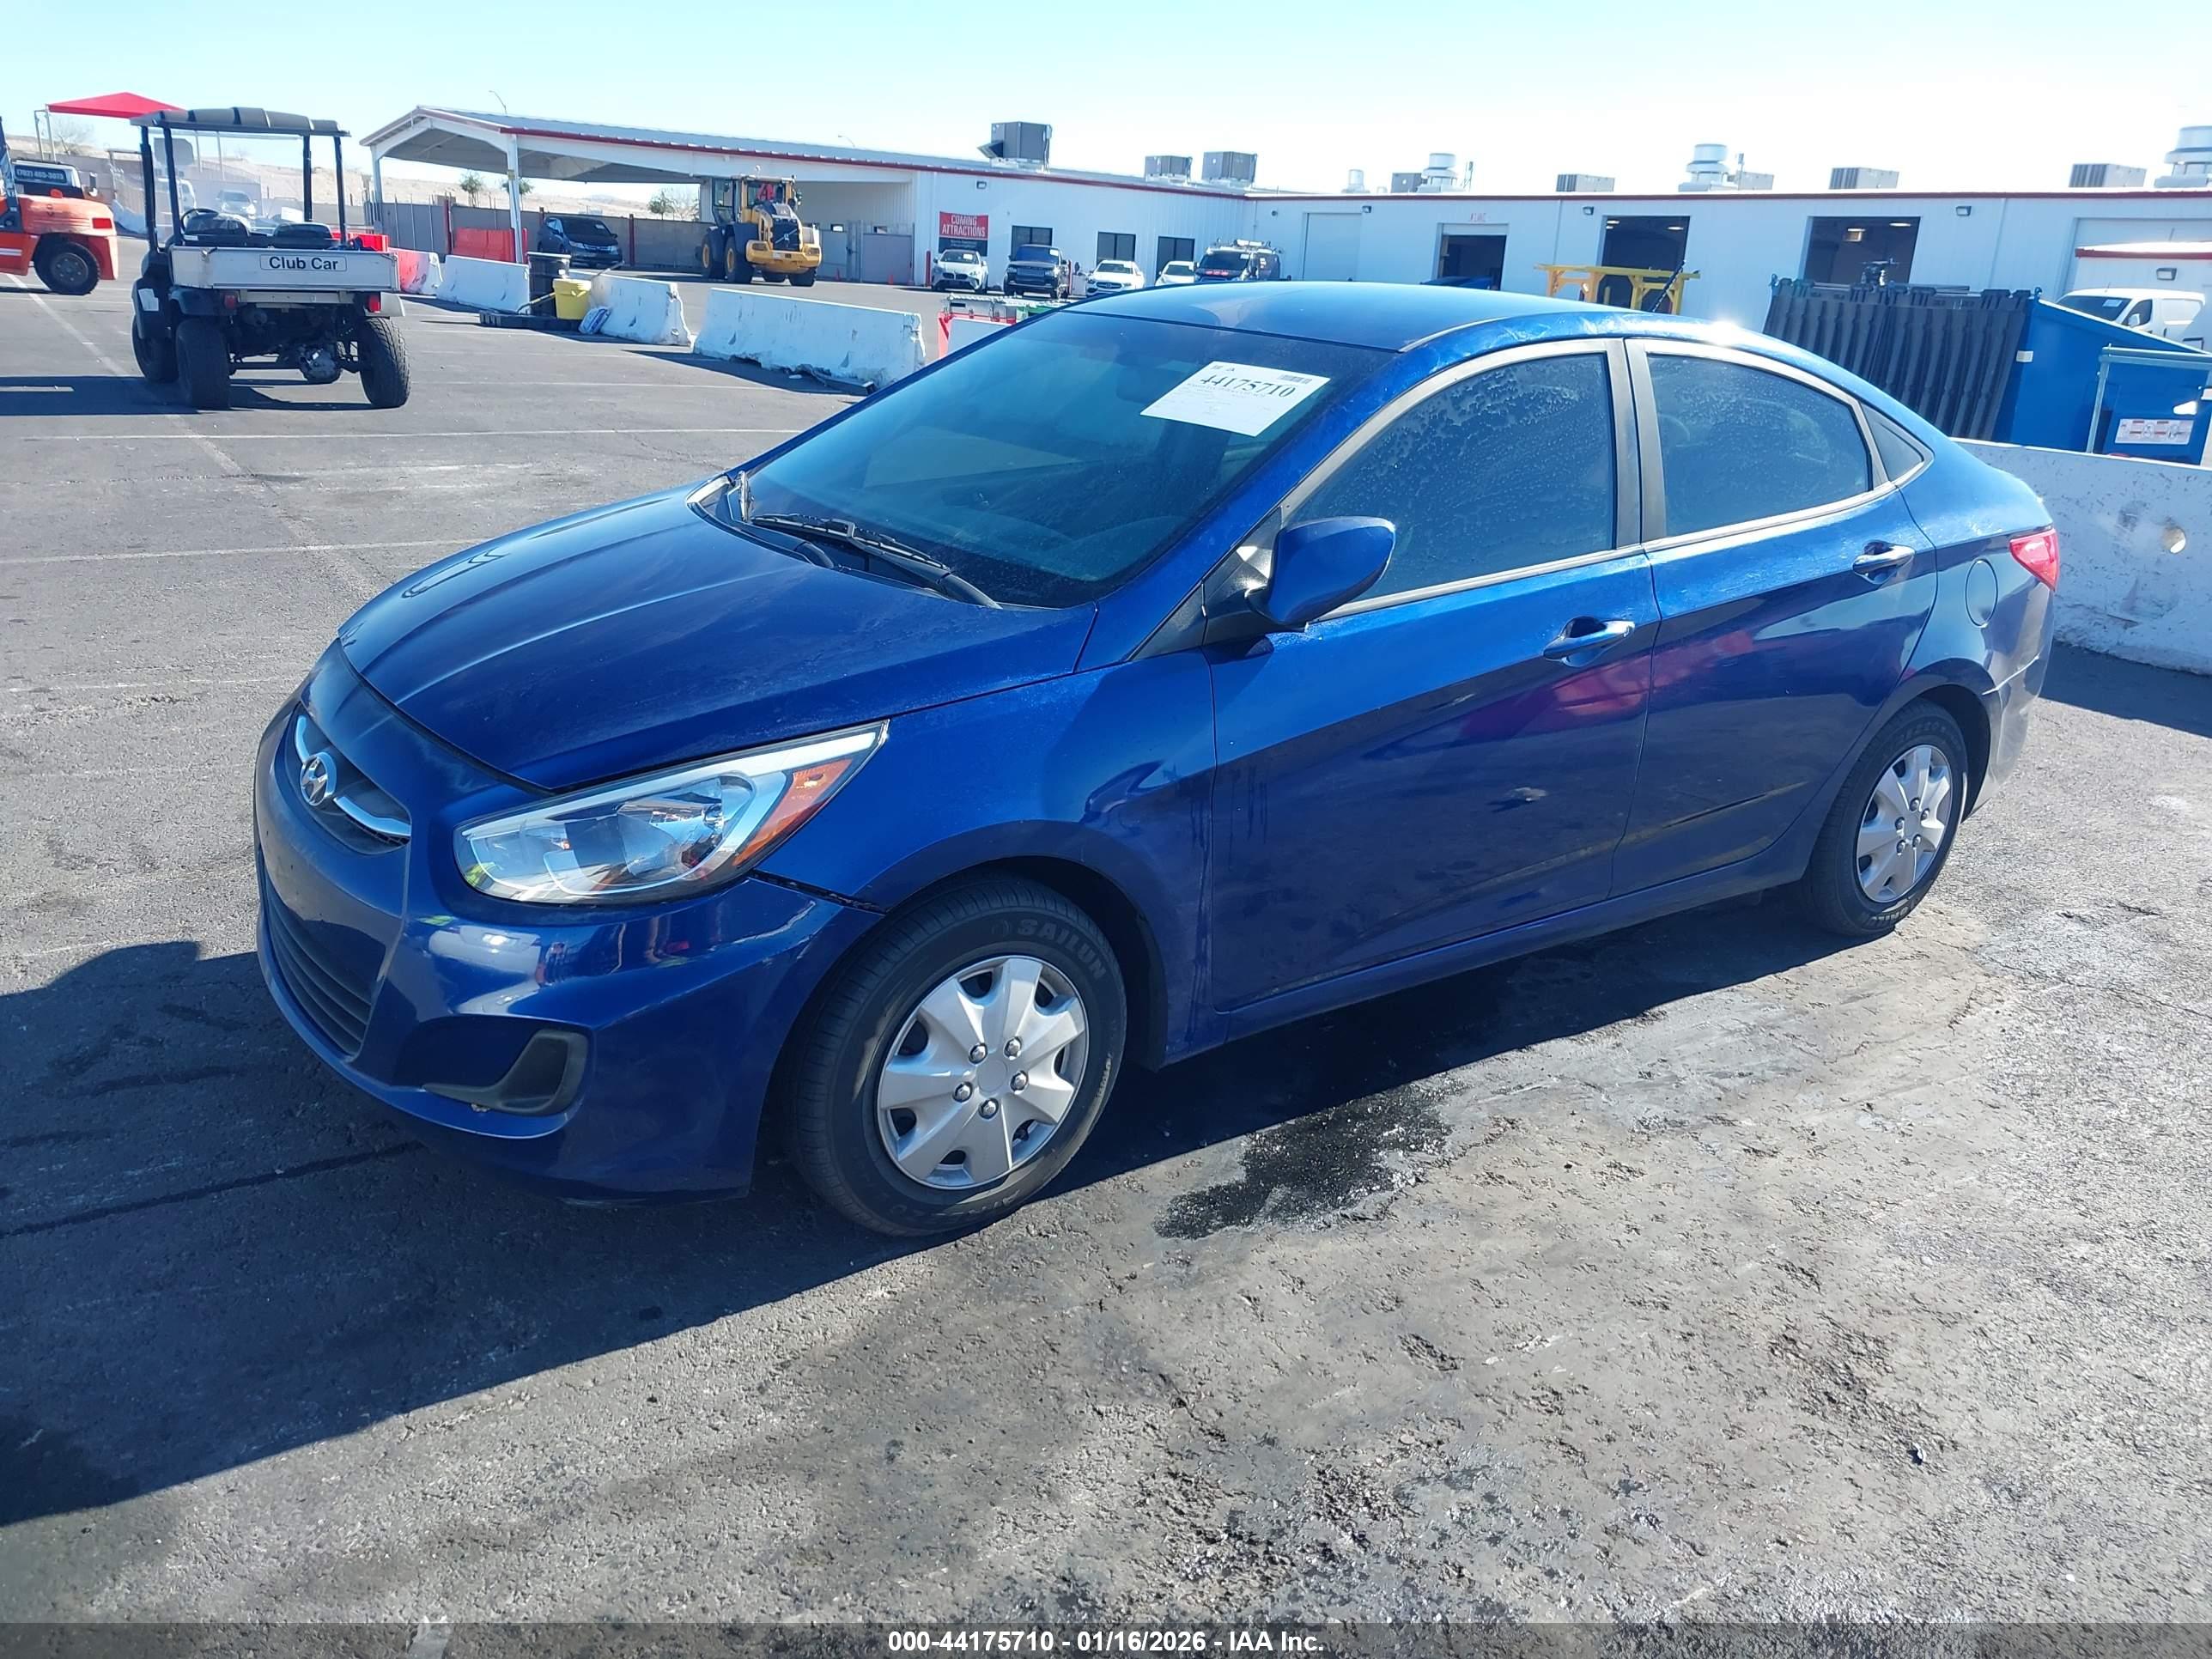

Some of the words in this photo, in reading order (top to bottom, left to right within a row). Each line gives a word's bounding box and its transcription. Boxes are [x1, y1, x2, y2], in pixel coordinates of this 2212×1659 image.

[951, 214, 977, 226] COMING
[941, 223, 986, 238] ATTRACTIONS
[269, 256, 307, 270] Club
[311, 257, 338, 270] Car
[1200, 374, 1297, 398] 44175710
[1017, 918, 1107, 979] SAILUN
